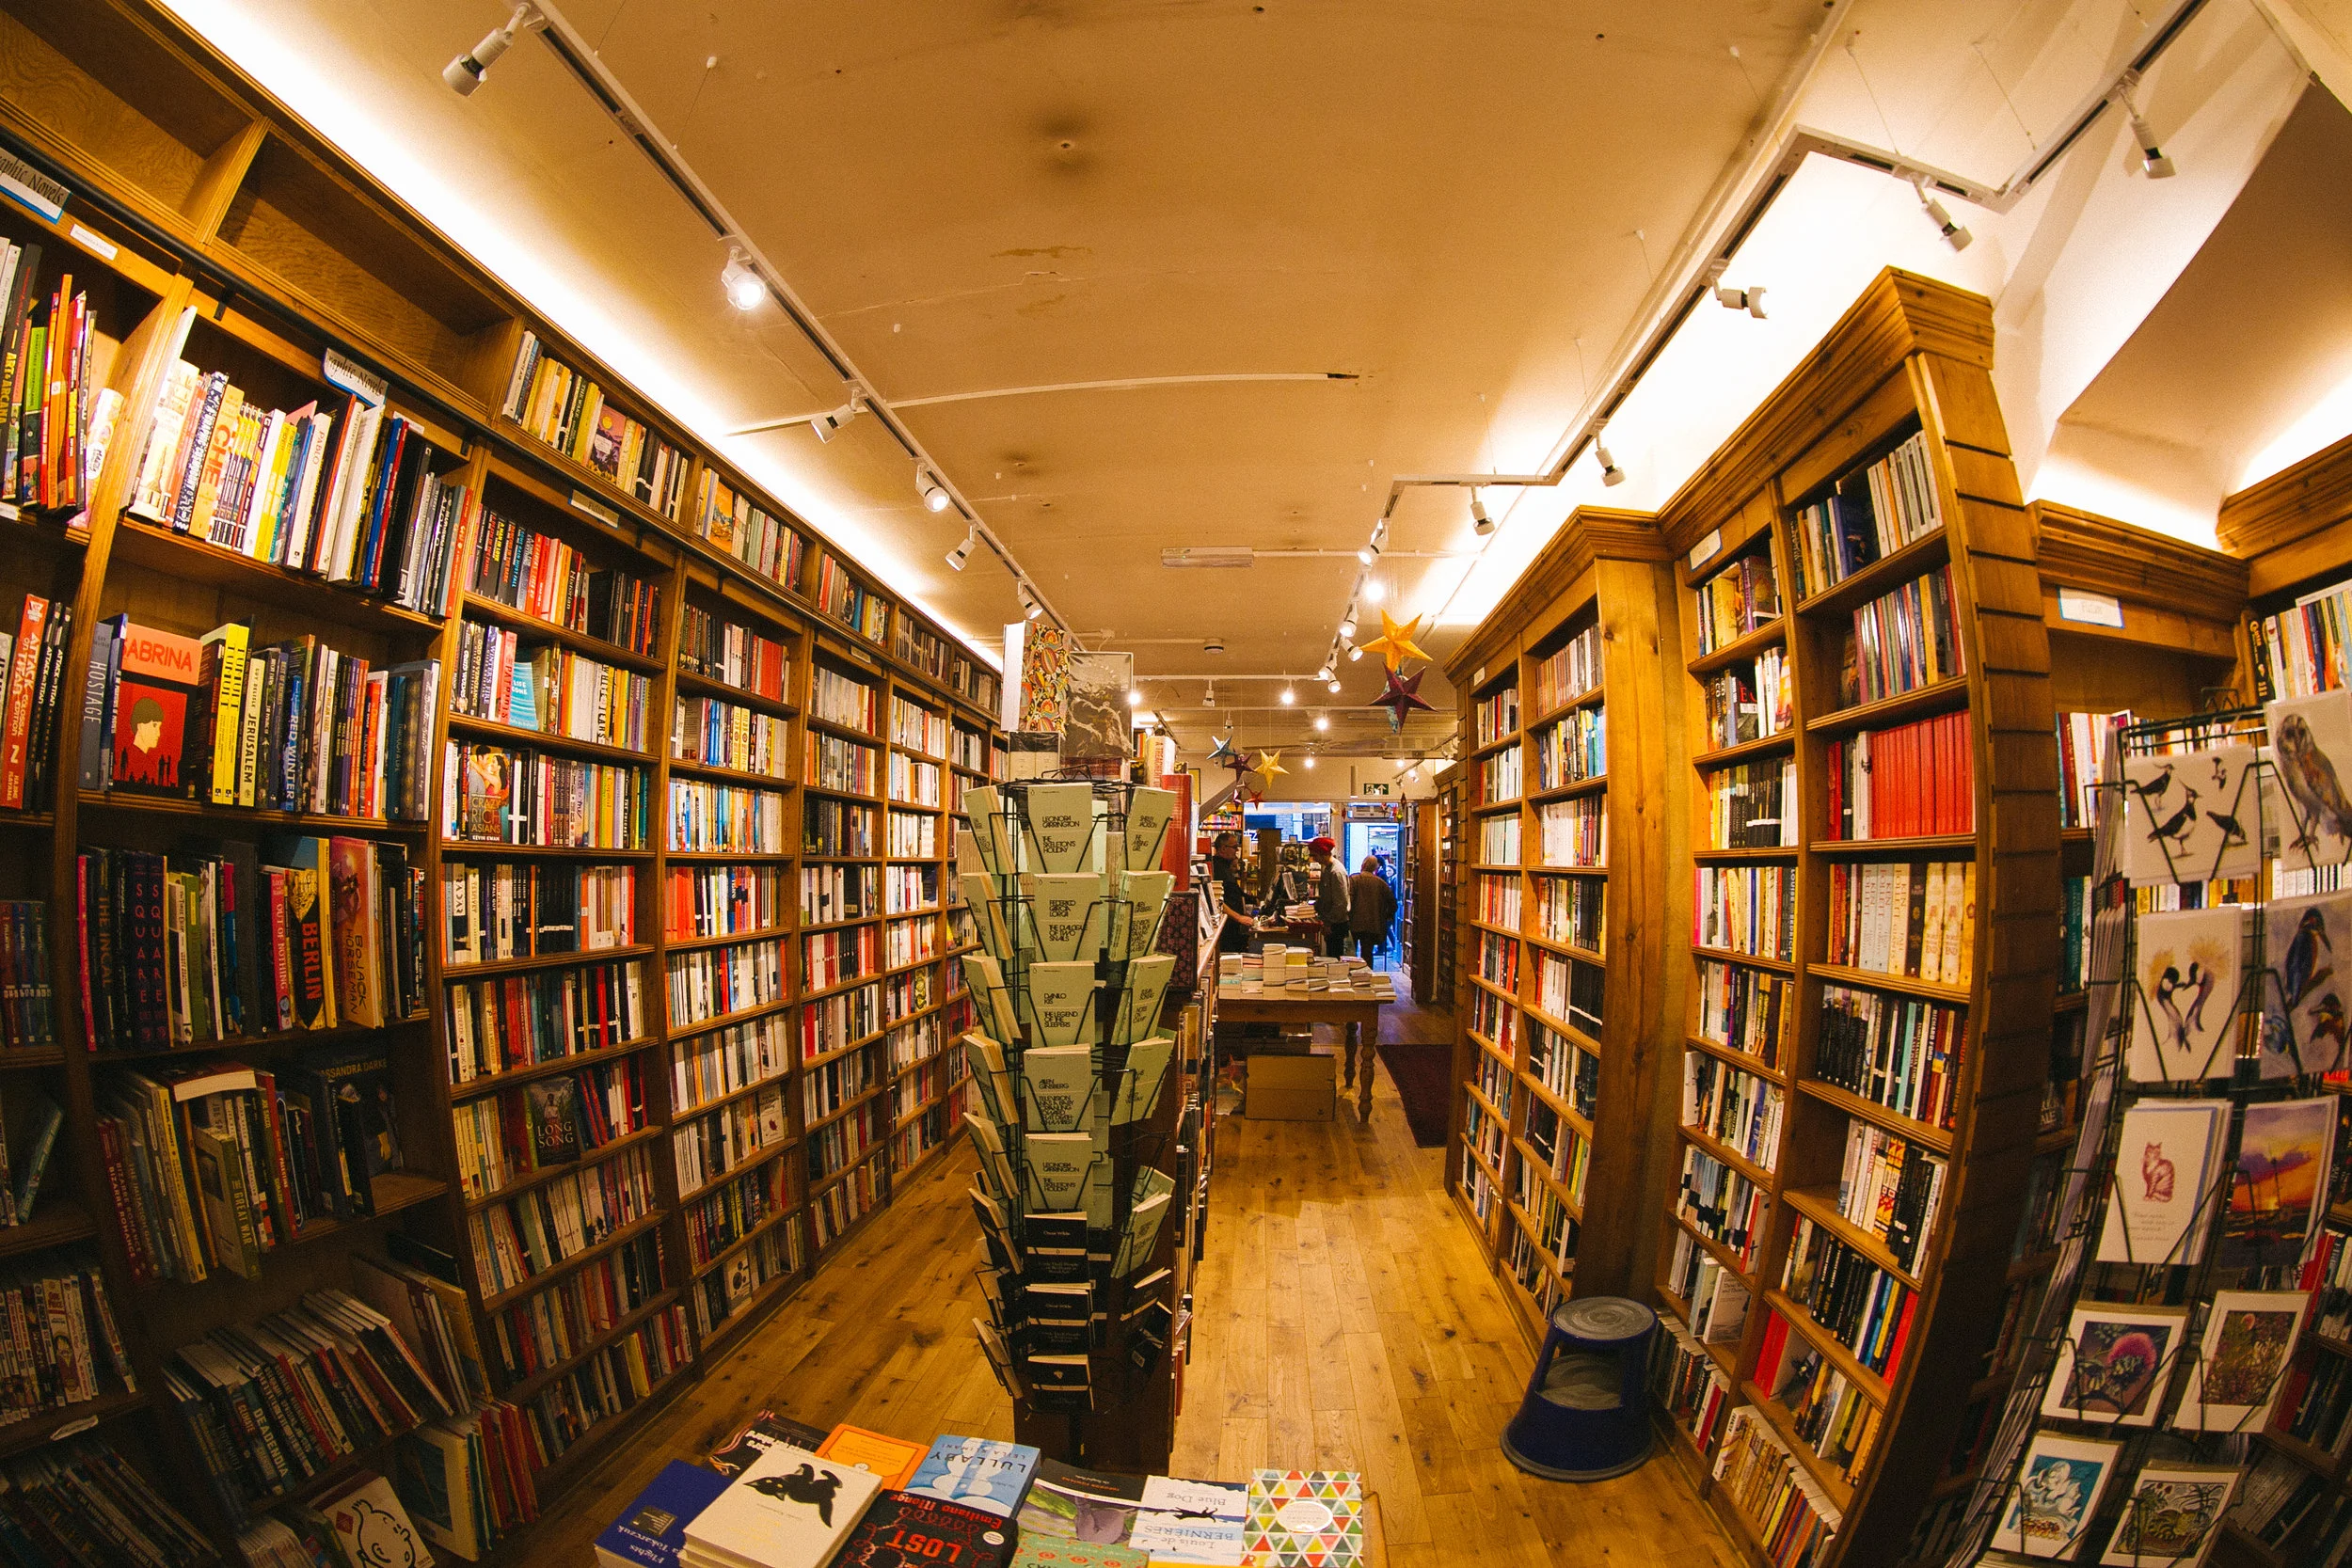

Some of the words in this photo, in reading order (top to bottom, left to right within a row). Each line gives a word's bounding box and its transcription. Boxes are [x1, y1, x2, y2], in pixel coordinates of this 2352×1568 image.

[0, 155, 27, 182] raphic
[27, 174, 64, 204] Novels
[327, 355, 355, 380] raphic
[357, 372, 384, 398] Novels
[203, 424, 230, 487] CHE
[310, 431, 326, 465] PABLO
[24, 632, 40, 689] ATTACK
[43, 646, 53, 674] ATTACK
[54, 649, 63, 676] ATTACK
[221, 646, 234, 707] TUMULT
[83, 661, 107, 724] HOSTAGE
[230, 649, 245, 708] TUMULT
[501, 665, 514, 719] PATRIOTS
[599, 664, 609, 700] WHITE
[17, 694, 28, 736] COLOSSAL
[289, 715, 298, 741] RED
[597, 703, 606, 738] TEARS
[244, 713, 257, 784] JERUSALEM
[286, 744, 297, 800] WINTER
[471, 797, 500, 808] CRAZY
[471, 809, 500, 822] RICH
[1042, 815, 1072, 823] LEONORA
[471, 823, 501, 832] ASIANS
[98, 896, 110, 927] THE
[275, 904, 283, 925] OUT
[135, 883, 148, 1003] SQUARE
[151, 883, 163, 1003] SQUARE
[277, 927, 283, 941] OF
[99, 932, 113, 988] INCAL
[277, 942, 288, 990] NOTHING
[301, 922, 323, 1000] BERLIN
[346, 928, 358, 1015] HORSEMAN
[355, 934, 367, 1010] BOJACK
[320, 1063, 362, 1079] ASSANDRA
[537, 1121, 572, 1137] LONG
[537, 1132, 574, 1148] SONG
[108, 1166, 121, 1208] BIZARRE
[120, 1212, 136, 1258] ROMANCE
[116, 1163, 128, 1204] BIZARRE
[127, 1206, 141, 1252] ROMANCE
[233, 1193, 246, 1223] GREAT
[240, 1224, 252, 1245] WAR
[253, 1407, 289, 1478] DEADENDIA
[942, 1443, 987, 1454] SLIMANI
[993, 1449, 1025, 1459] LEILA
[930, 1451, 1026, 1473] LULLABY
[889, 1494, 937, 1512] Monge
[1166, 1492, 1193, 1504] Dog
[1198, 1497, 1227, 1506] Blue
[940, 1505, 1003, 1529] Emiliano
[1144, 1525, 1234, 1541] BERNIÈRES
[617, 1525, 669, 1552] Tokarczuk
[629, 1544, 665, 1564] Flights
[885, 1529, 962, 1563] LOST
[1161, 1536, 1176, 1545] de
[1179, 1538, 1216, 1549] Louis
